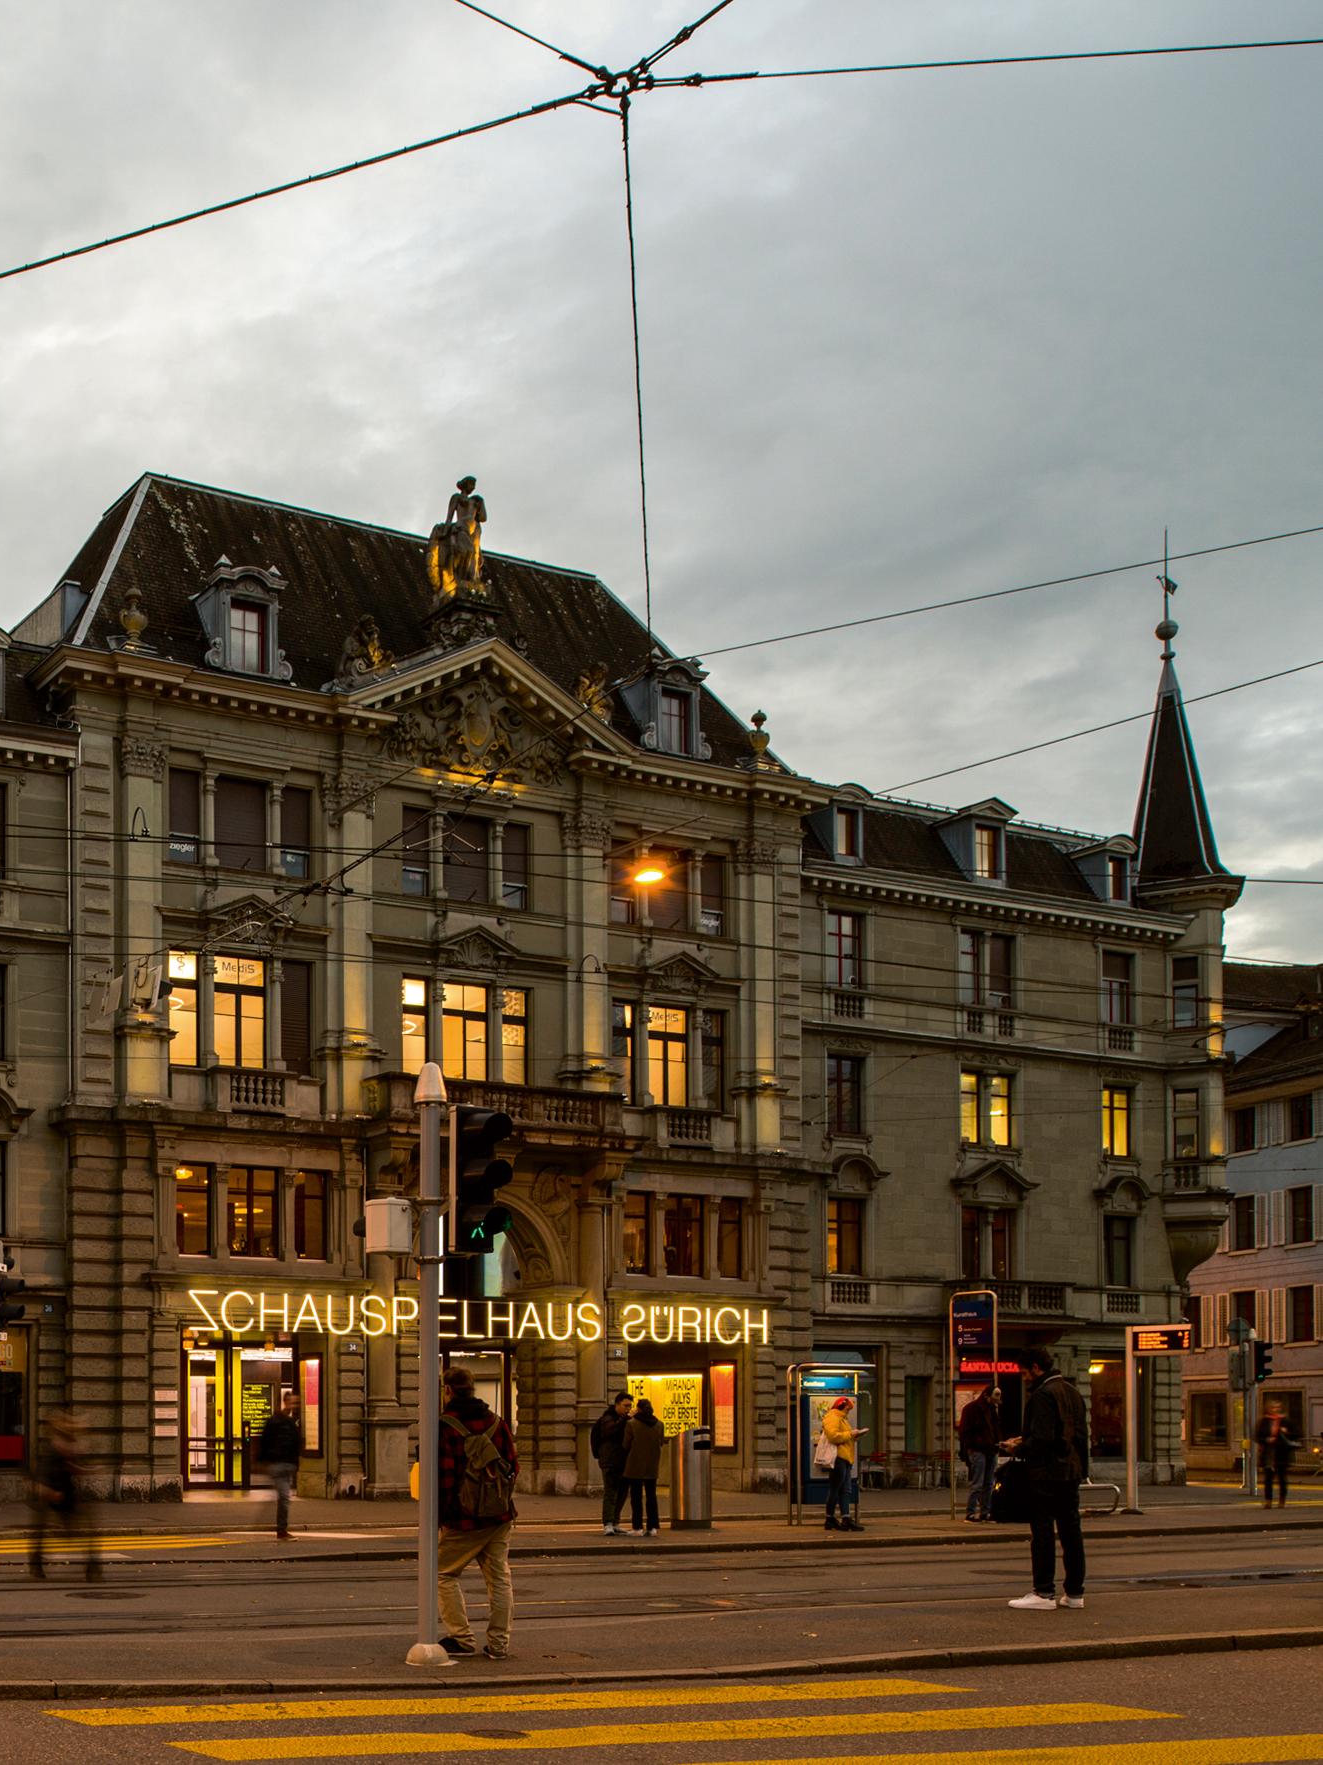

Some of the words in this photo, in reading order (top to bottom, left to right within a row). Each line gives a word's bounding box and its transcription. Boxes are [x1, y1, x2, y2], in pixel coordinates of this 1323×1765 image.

[169, 843, 195, 852] ziegler
[221, 961, 255, 974] MediS
[958, 1324, 963, 1333] 5
[958, 1337, 963, 1345] 9
[349, 1344, 358, 1352] 34
[960, 1361, 990, 1373] SANTA
[630, 1379, 644, 1396] THE
[665, 1379, 696, 1391] MIRANDA
[670, 1392, 691, 1404] JULYS
[663, 1406, 676, 1419] DER
[678, 1406, 698, 1419] ERSTE
